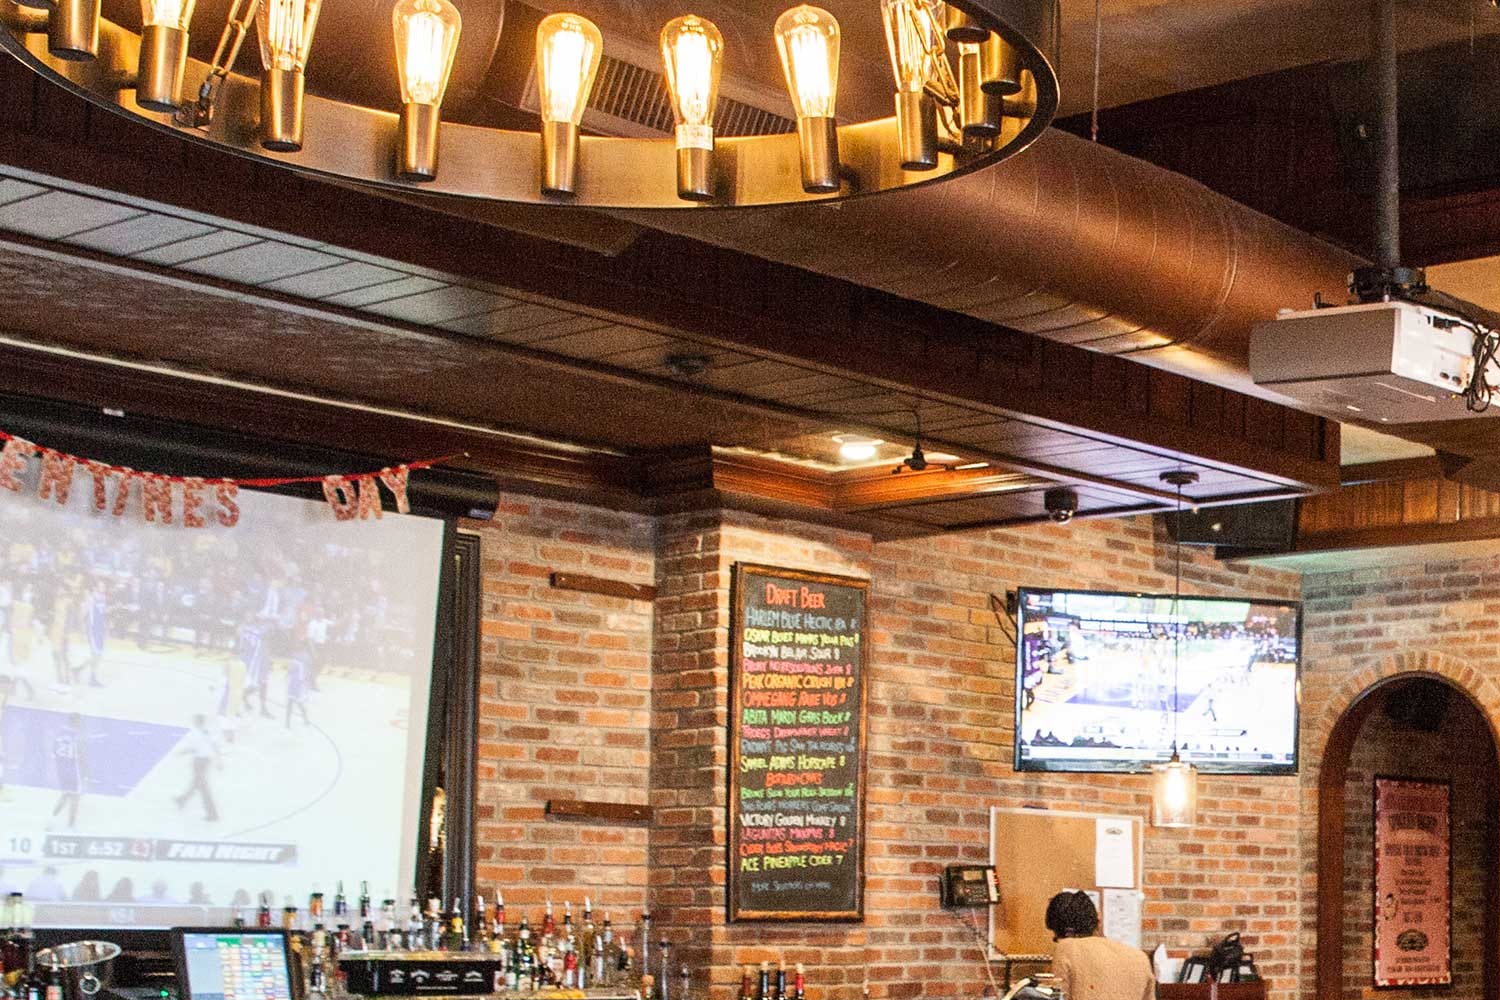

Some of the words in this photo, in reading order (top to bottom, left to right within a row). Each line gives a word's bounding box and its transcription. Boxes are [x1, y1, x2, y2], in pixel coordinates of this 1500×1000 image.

[321, 465, 411, 521] DAY
[800, 586, 826, 609] BEER
[741, 857, 760, 872] ACE
[763, 855, 808, 871] PINEAPPLE
